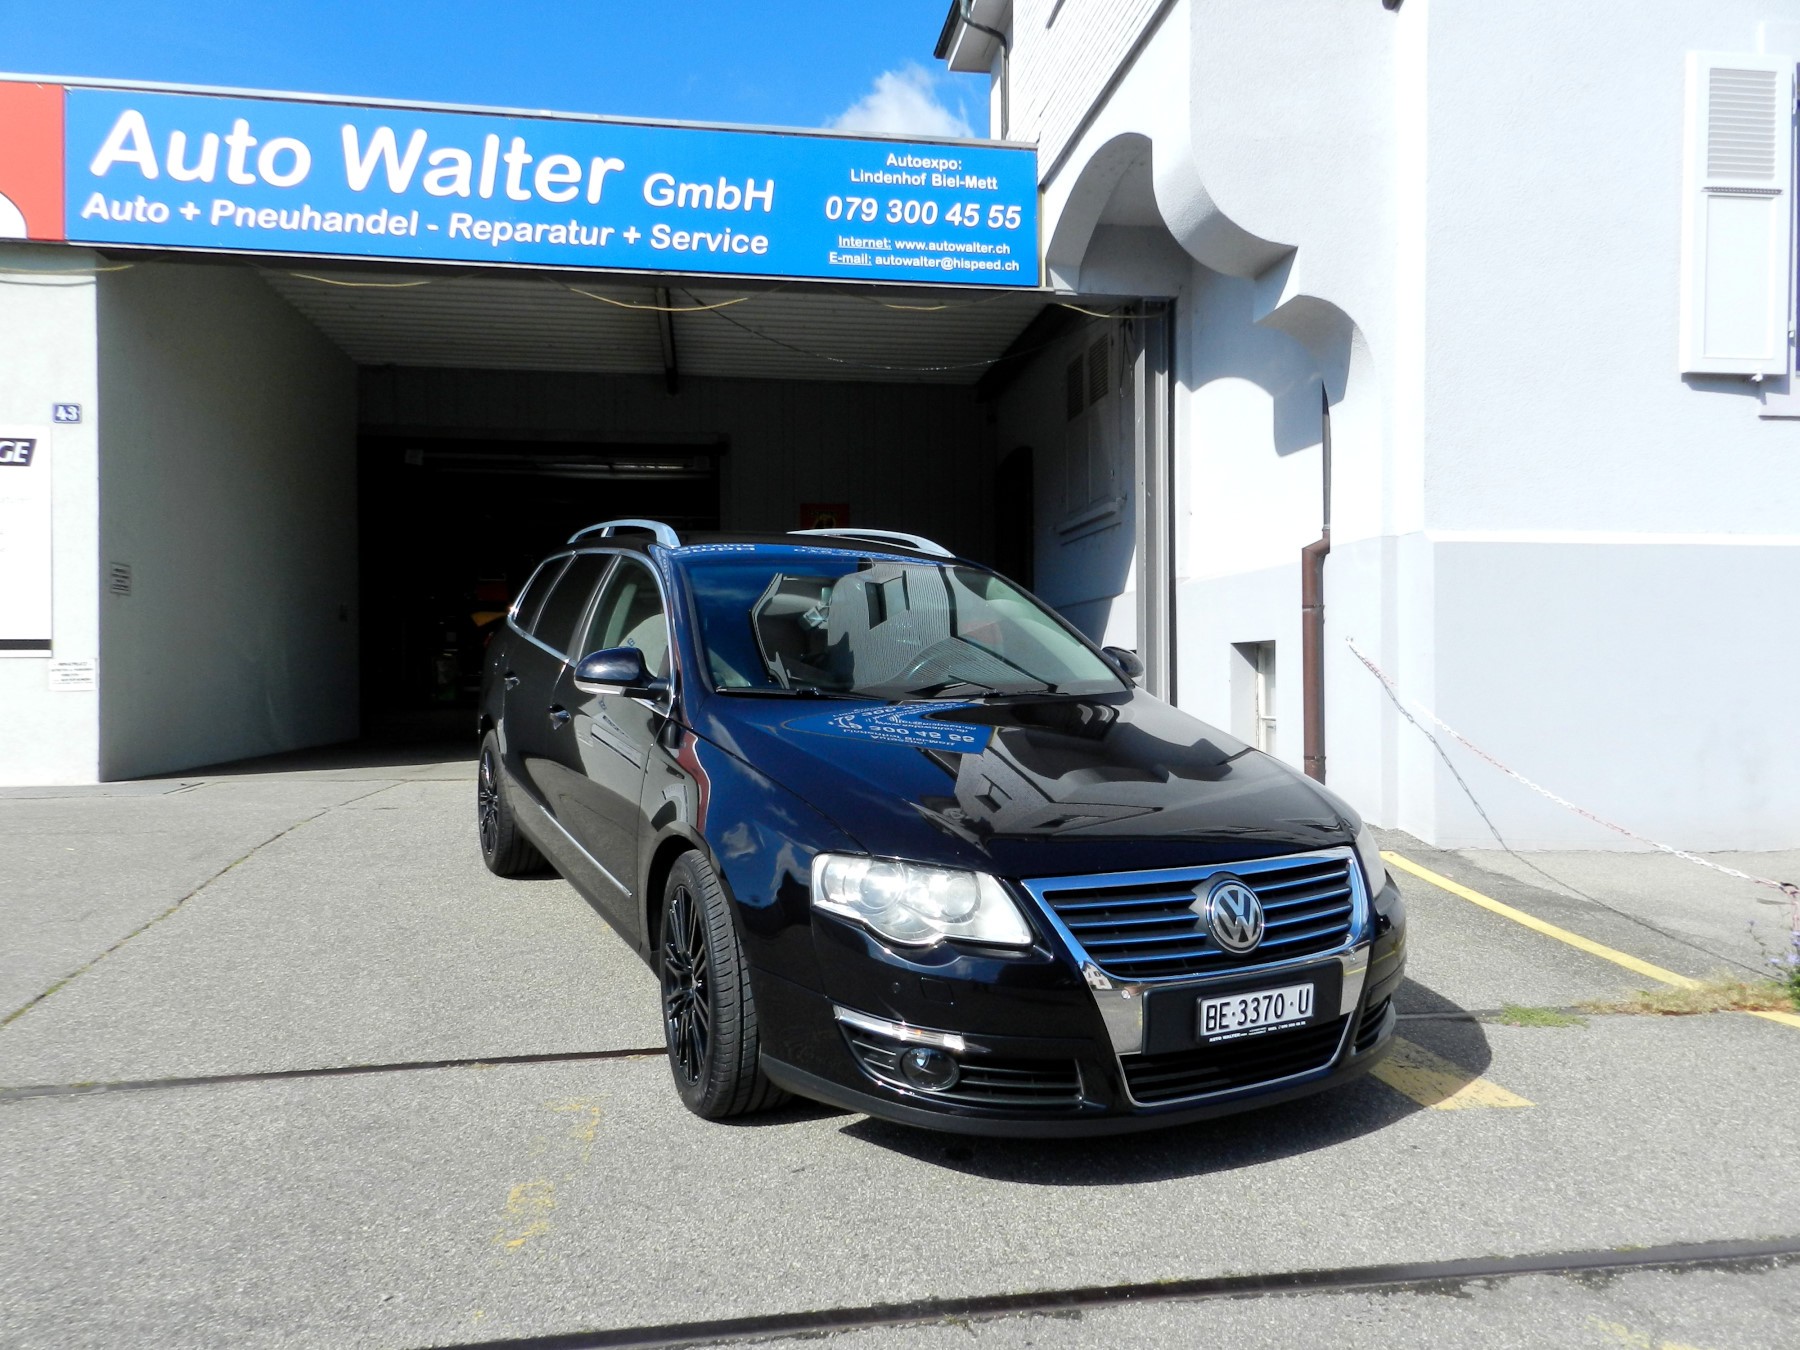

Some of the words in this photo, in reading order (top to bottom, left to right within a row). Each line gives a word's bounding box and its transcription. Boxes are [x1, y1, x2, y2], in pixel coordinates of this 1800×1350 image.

[90, 109, 311, 187] Auto
[342, 124, 625, 204] Walter
[643, 172, 775, 213] GmbH
[886, 153, 962, 172] Autoexpo:
[850, 169, 927, 186] Lindenhof
[932, 173, 998, 190] Biel-Mett
[825, 196, 878, 222] 079
[886, 199, 938, 225] 300
[945, 203, 980, 227] 45
[987, 204, 1022, 229] 55
[82, 192, 170, 223] Auto
[179, 201, 201, 221] +
[210, 199, 419, 237] Pneuhandel
[449, 212, 615, 247] Reparatur
[623, 226, 642, 245] +
[651, 224, 769, 255] Service
[838, 235, 892, 249] Internet:
[895, 239, 1011, 254] www.autowalter.ch
[829, 251, 872, 265] E-mail:
[875, 254, 1020, 271] autowalter@hispeed.ch
[56, 405, 79, 421] 43
